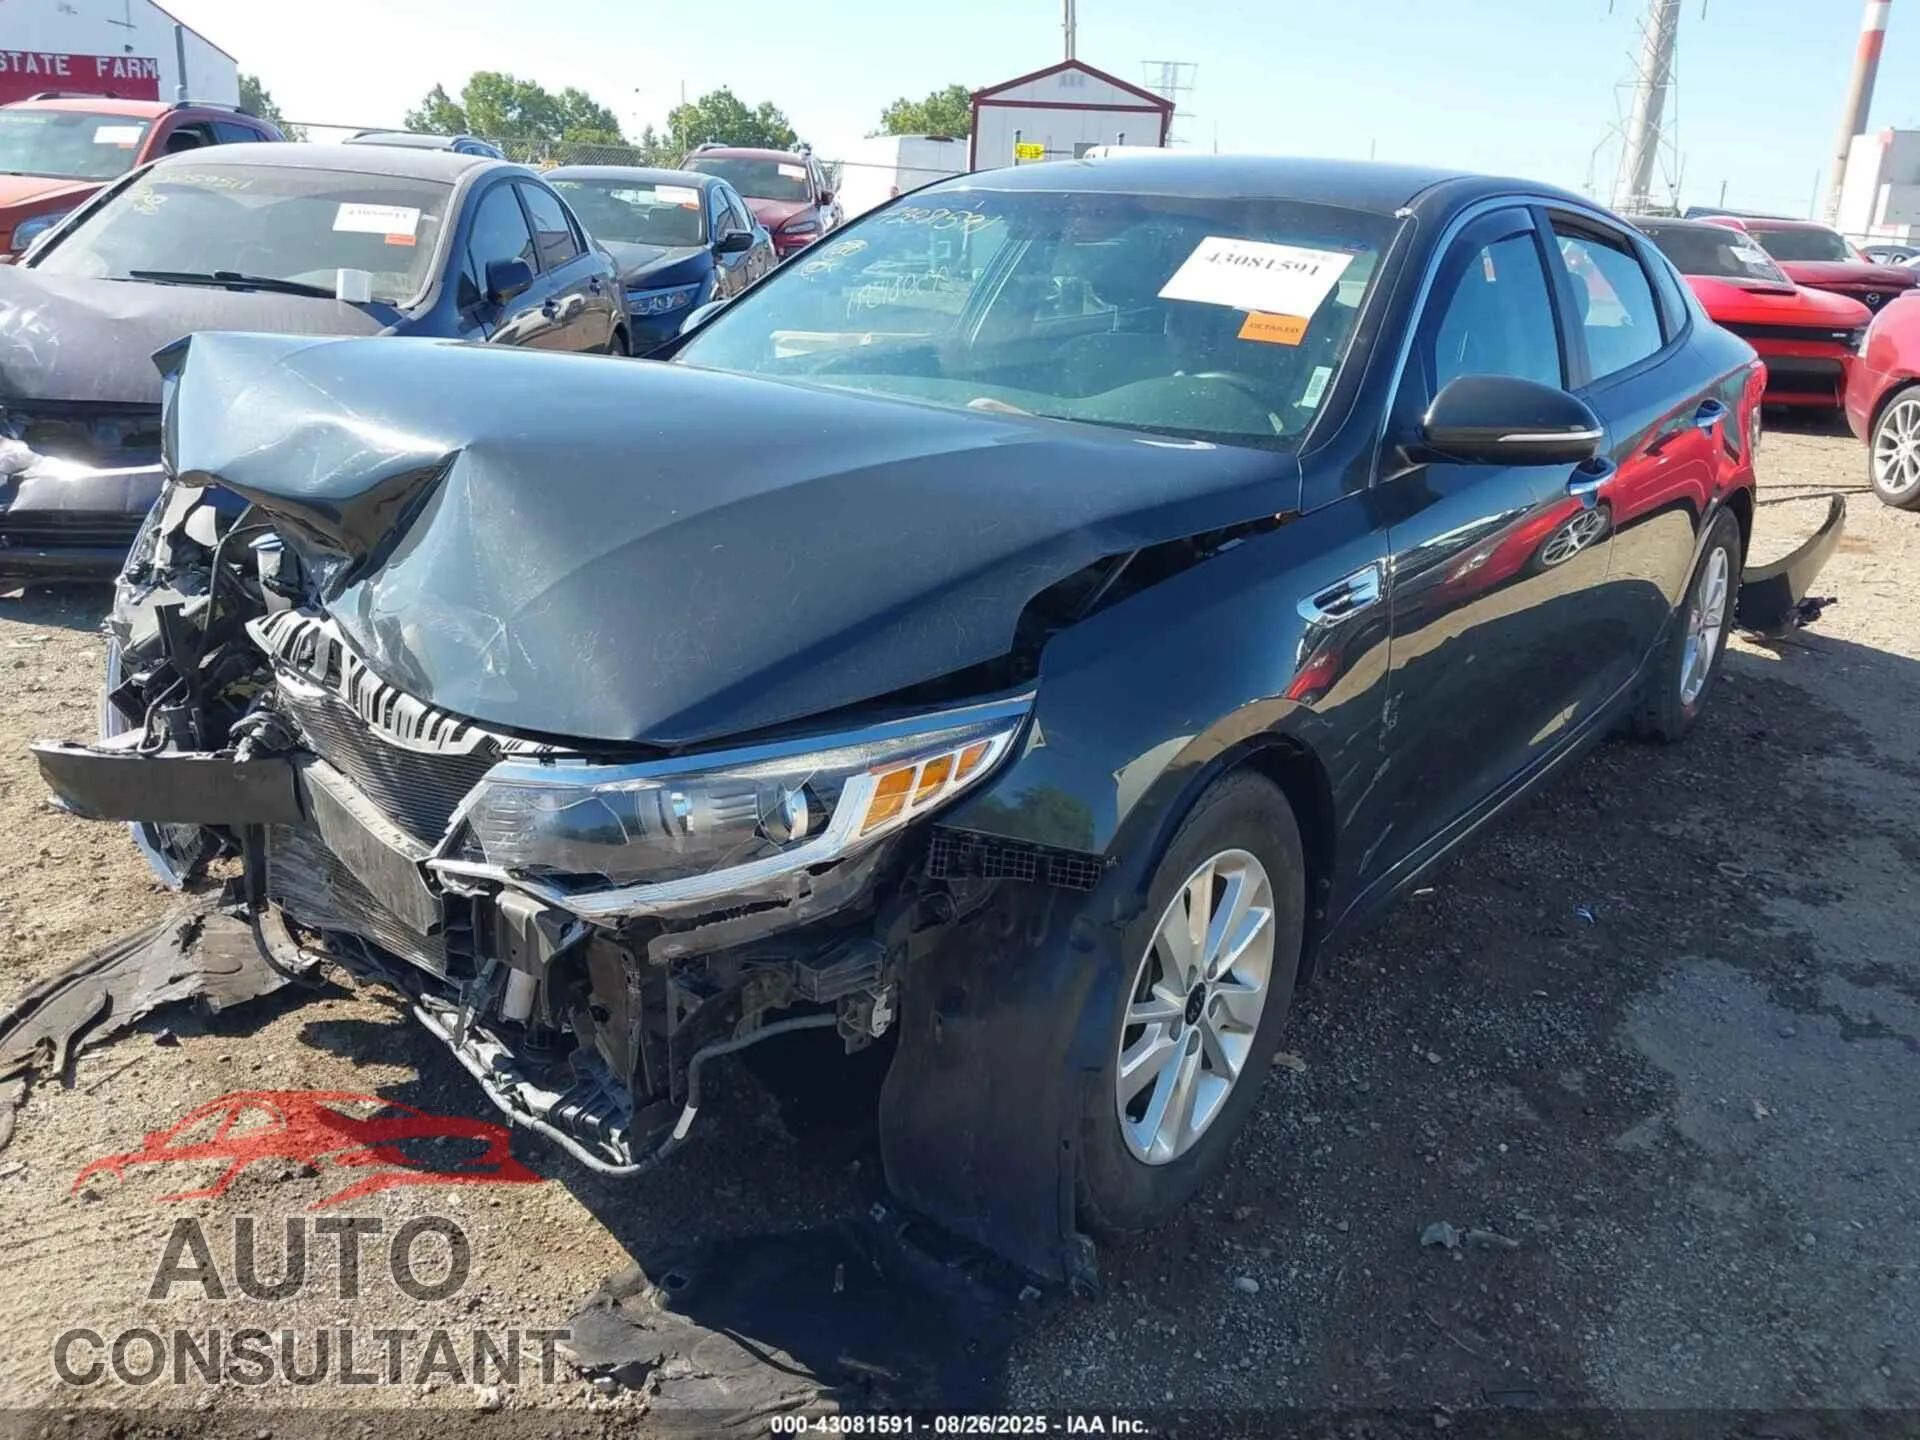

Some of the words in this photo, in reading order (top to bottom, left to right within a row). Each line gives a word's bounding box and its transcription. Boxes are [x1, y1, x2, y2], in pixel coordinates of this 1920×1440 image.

[0, 51, 72, 76] STATE
[95, 57, 158, 80] FARM
[1205, 251, 1320, 276] 43081591
